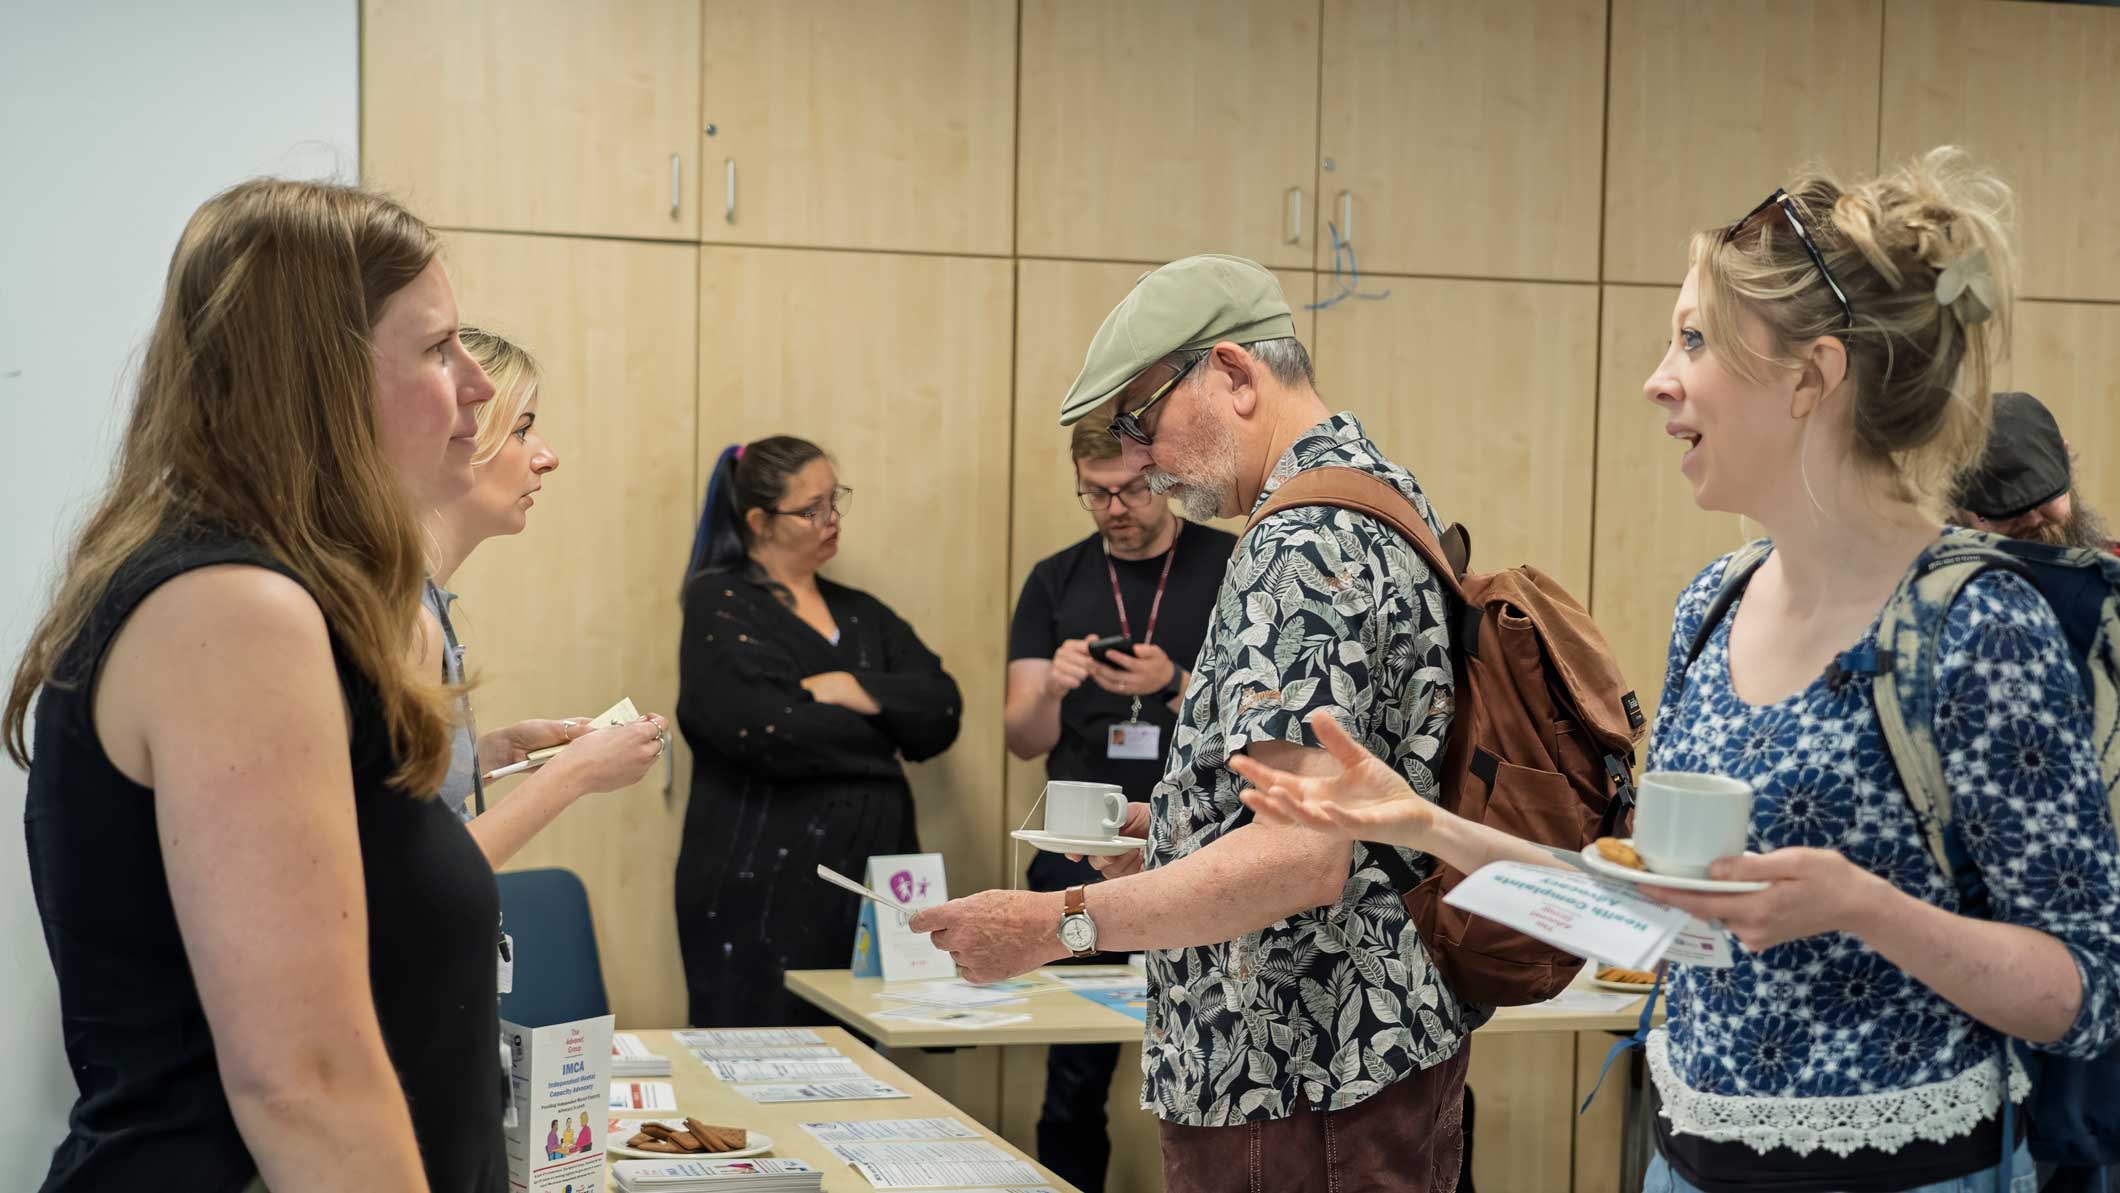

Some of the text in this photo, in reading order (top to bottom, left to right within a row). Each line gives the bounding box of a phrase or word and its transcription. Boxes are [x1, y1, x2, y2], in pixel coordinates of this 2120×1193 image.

[1492, 874, 1588, 911] Complaints
[1539, 877, 1619, 907] Advocacy
[1535, 920, 1554, 933] The
[1591, 906, 1649, 932] Health
[562, 1060, 585, 1075] IMCA
[548, 1073, 596, 1088] Independent Mental
[549, 1084, 594, 1098] Capacity Advocacy
